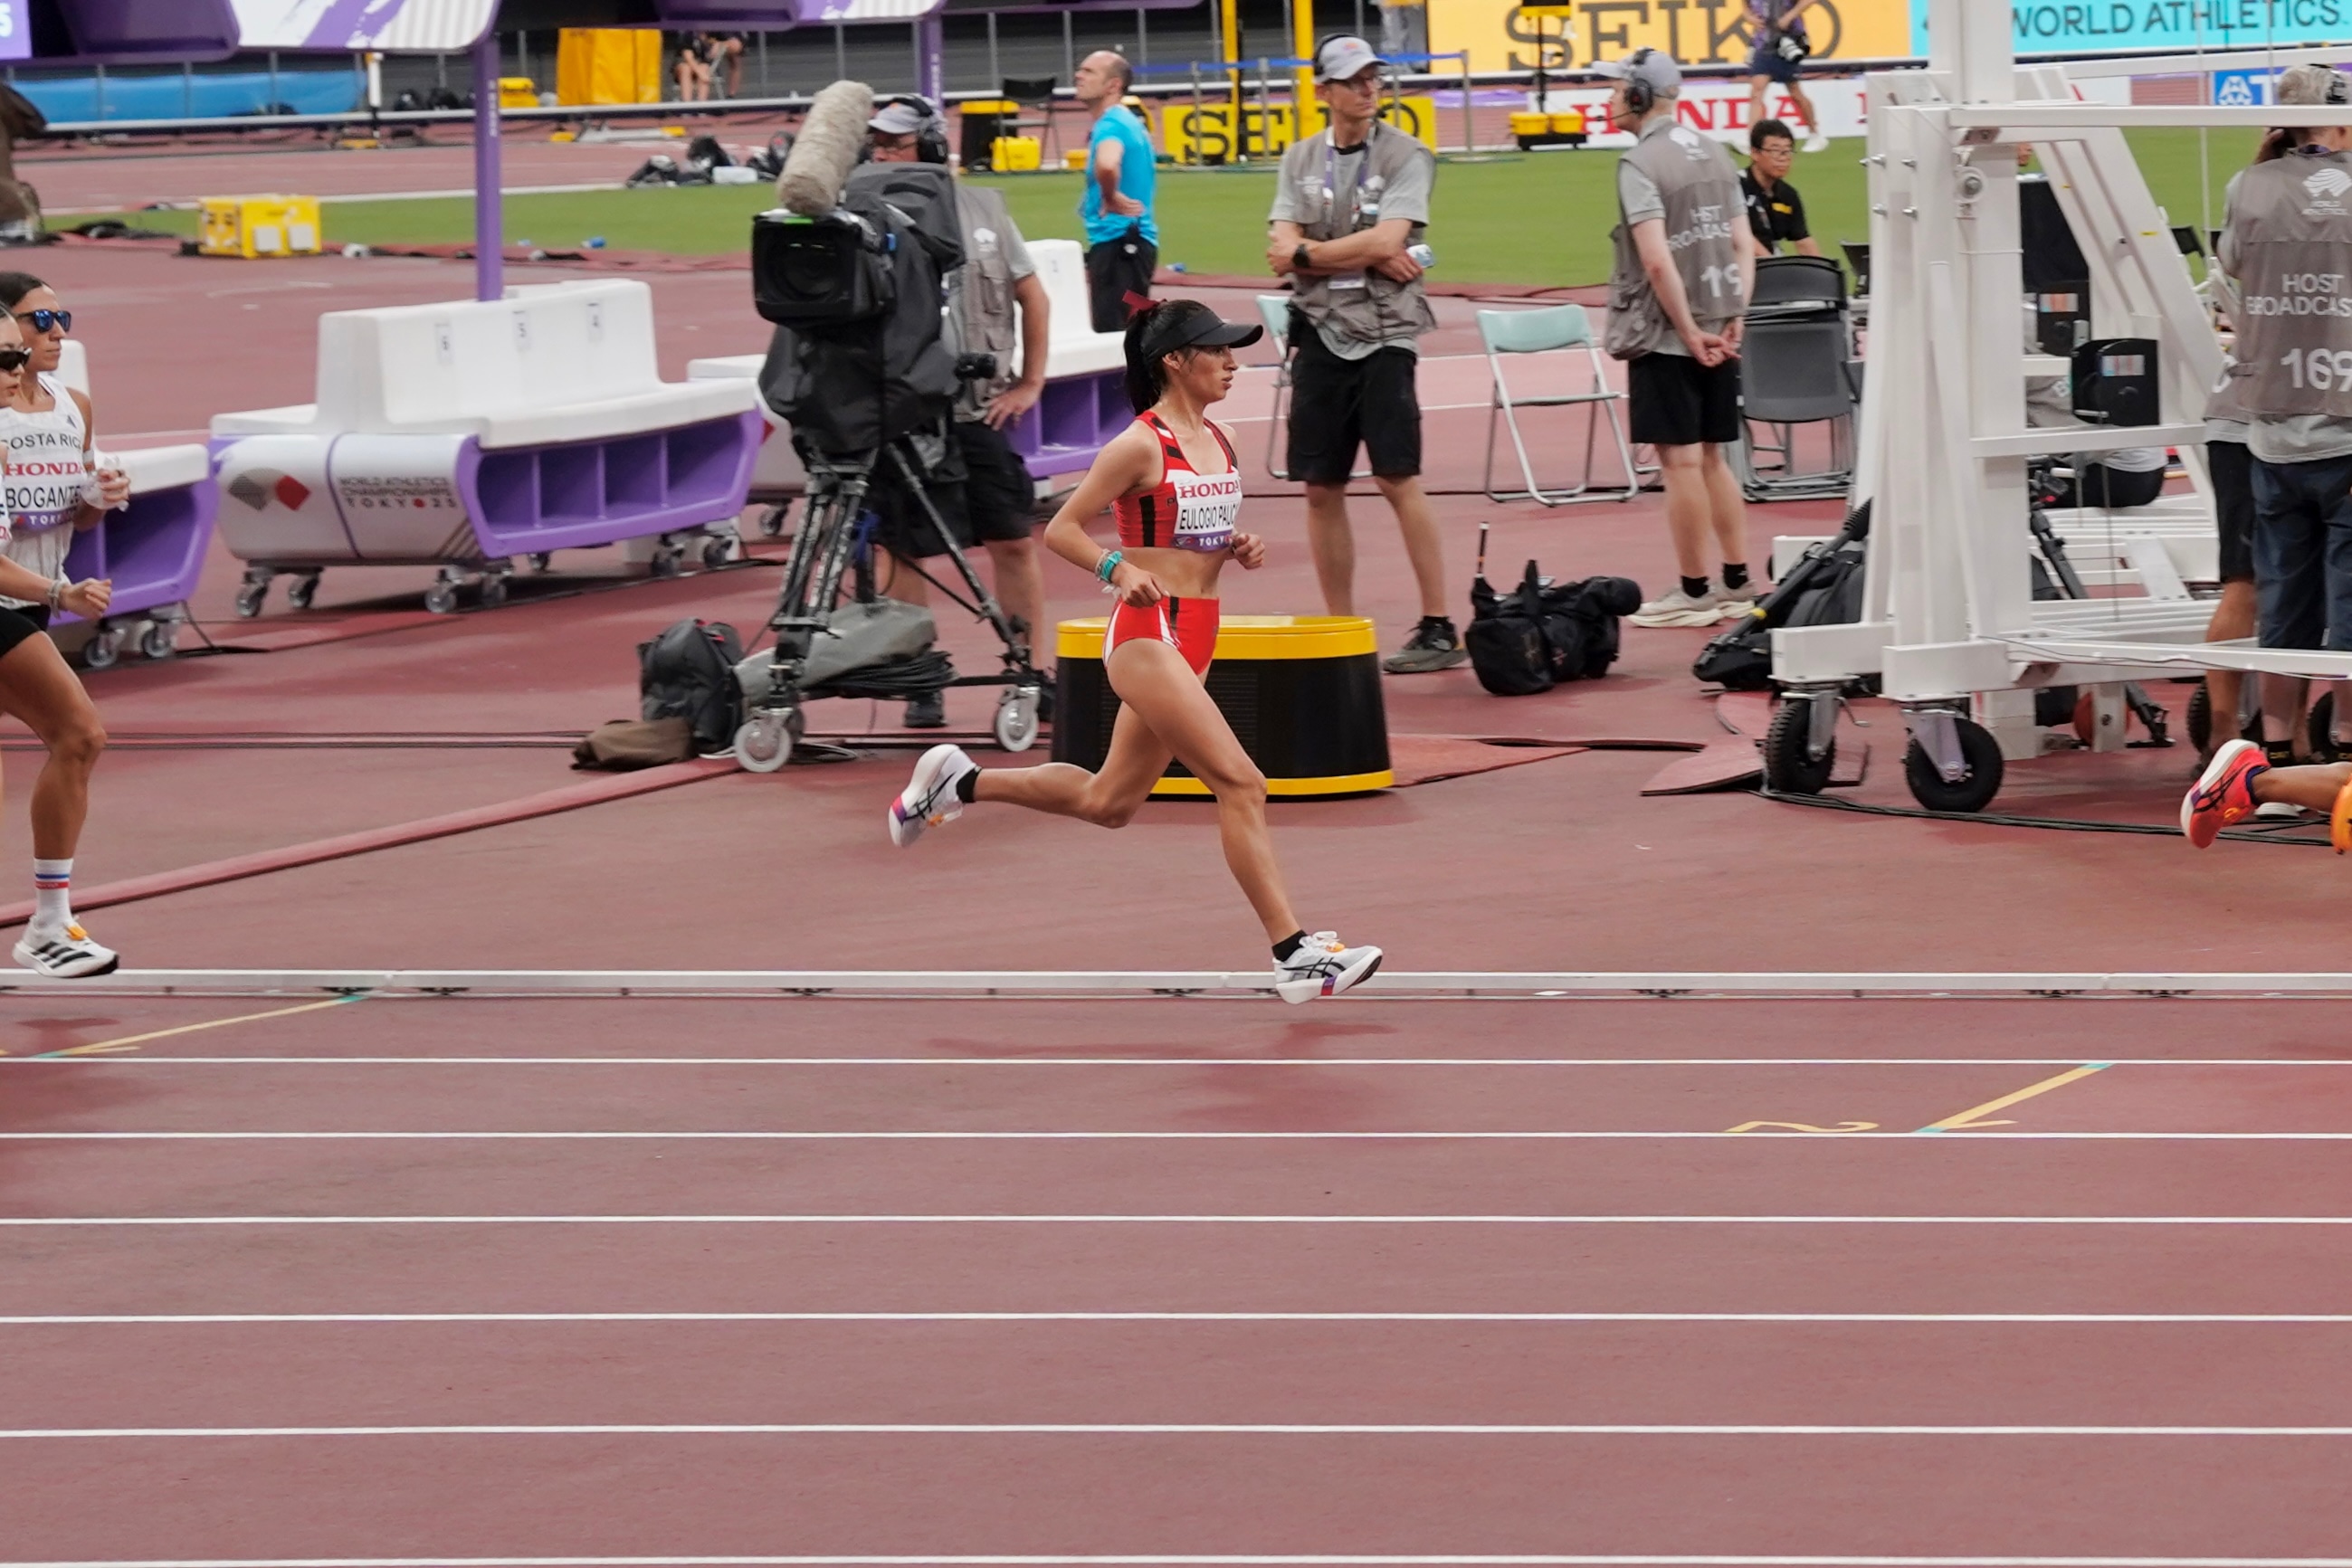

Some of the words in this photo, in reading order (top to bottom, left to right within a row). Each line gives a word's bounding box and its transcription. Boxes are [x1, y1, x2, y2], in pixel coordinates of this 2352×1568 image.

[2143, 0, 2340, 33] ATHLETICS
[1571, 95, 1814, 135] HNDA
[1182, 103, 1419, 165] SEO
[2281, 273, 2346, 293] HOST
[2281, 347, 2352, 392] 169
[1180, 507, 1217, 530] EULOGIO
